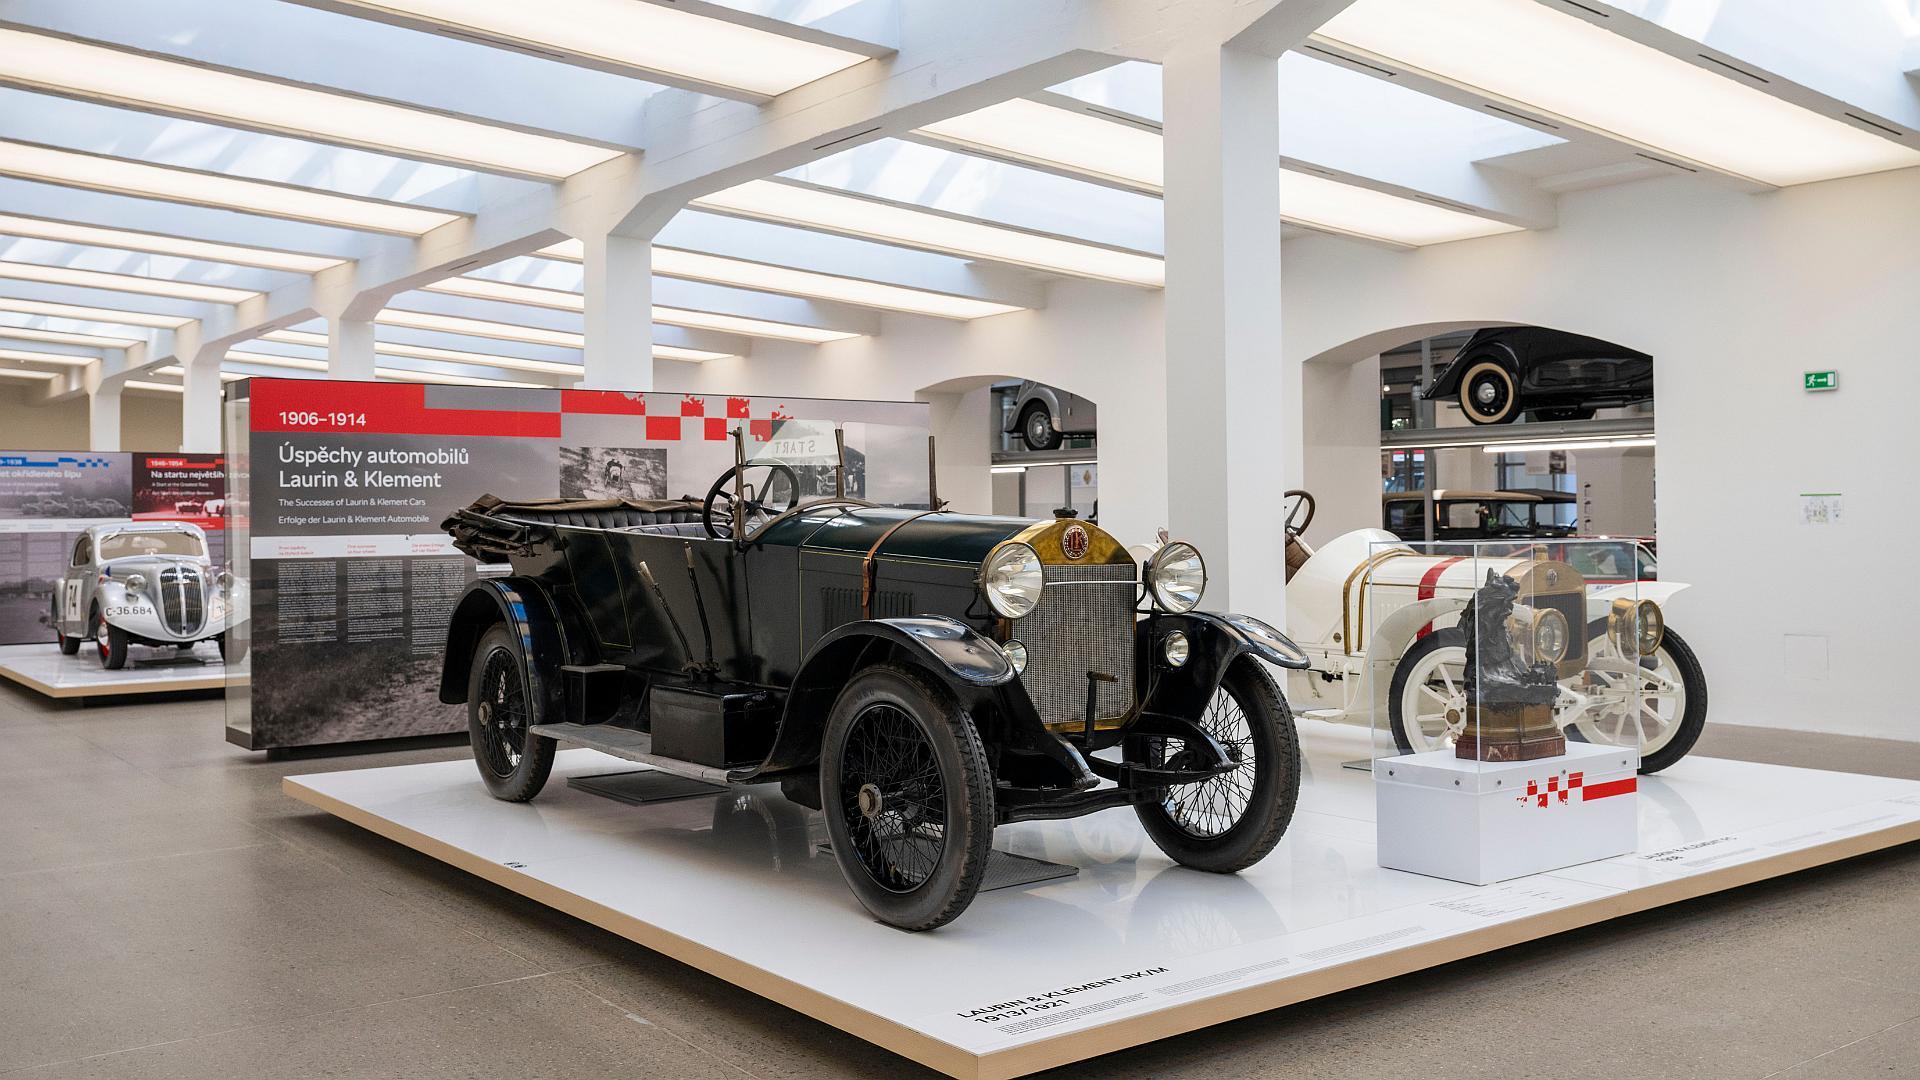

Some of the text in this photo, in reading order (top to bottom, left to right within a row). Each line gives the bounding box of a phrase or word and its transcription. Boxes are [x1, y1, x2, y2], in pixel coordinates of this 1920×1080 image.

[279, 412, 366, 426] 1906–1914
[279, 441, 469, 468] Úspěchy automobilů
[164, 471, 188, 479] startu
[279, 470, 442, 488] Laurin & Klement
[278, 516, 306, 526] Erfolge
[957, 1000, 1027, 1018] LAURIN
[1042, 978, 1121, 998] KLEMENT
[974, 1000, 1069, 1023] 1913/1921
